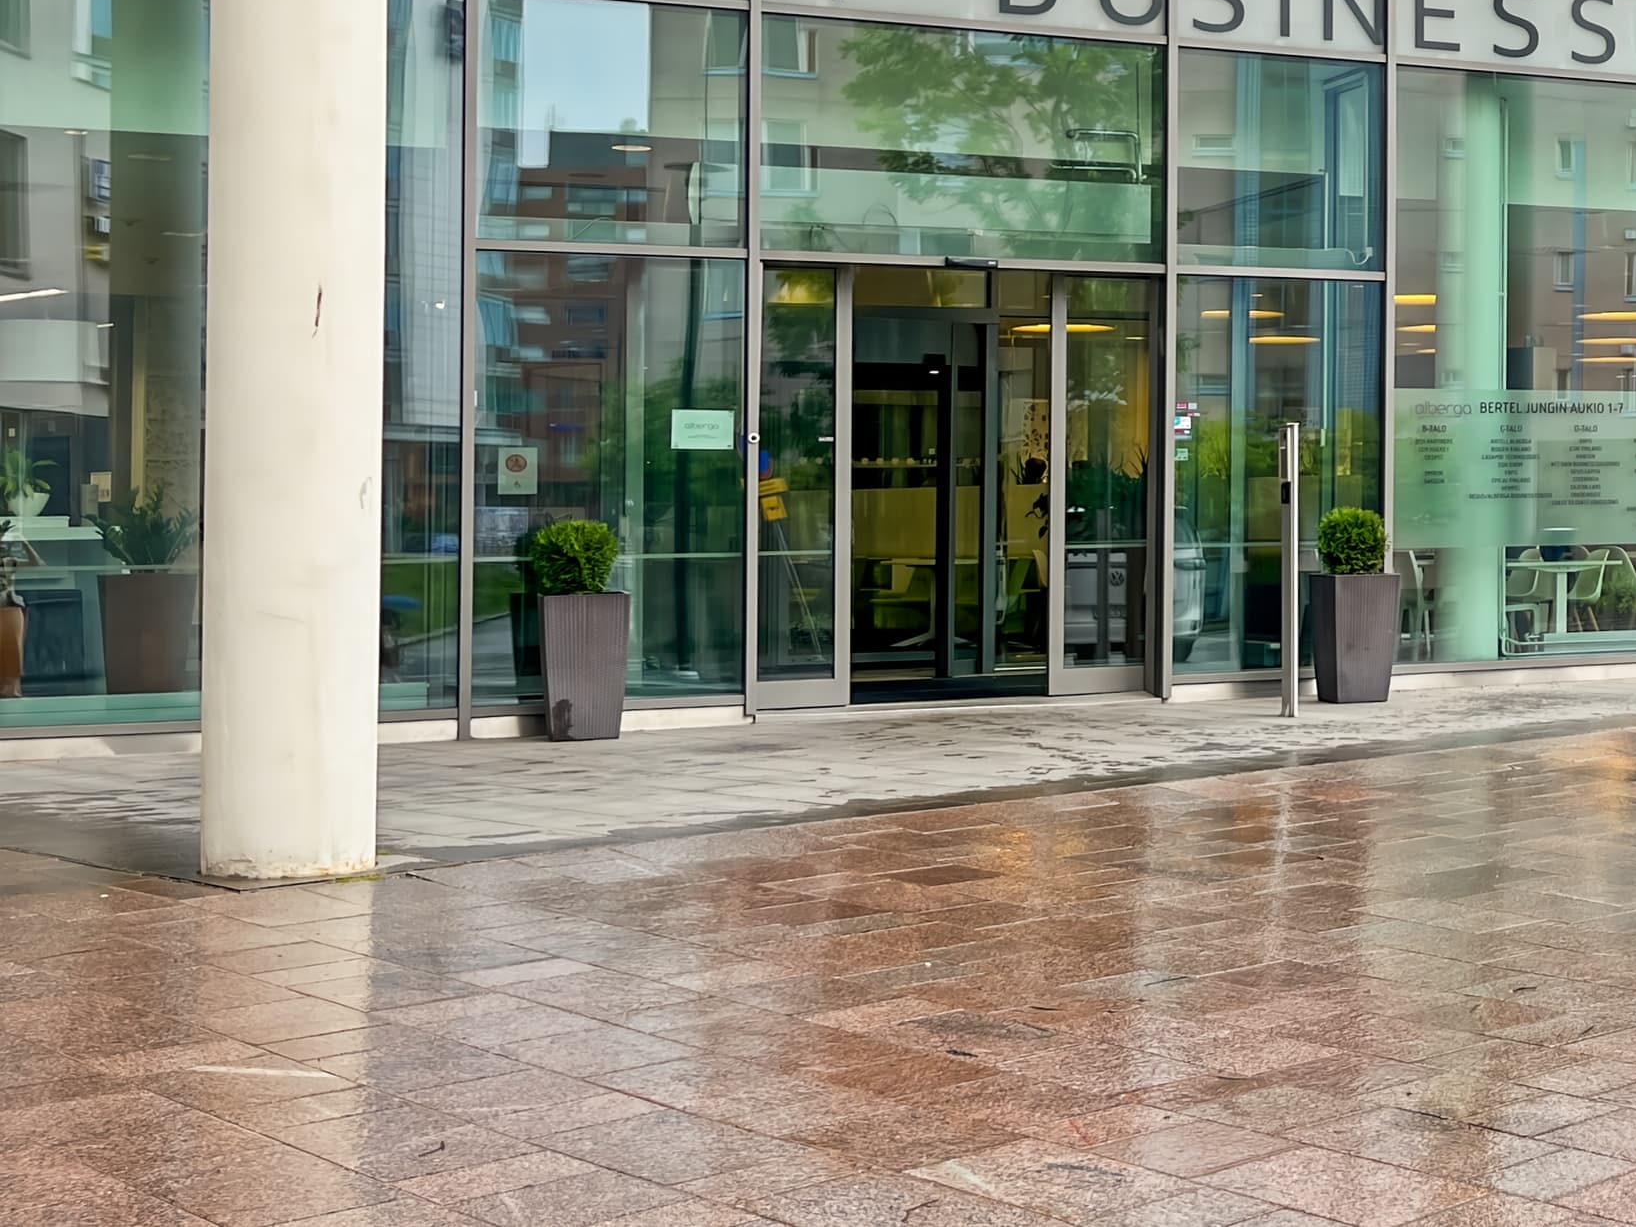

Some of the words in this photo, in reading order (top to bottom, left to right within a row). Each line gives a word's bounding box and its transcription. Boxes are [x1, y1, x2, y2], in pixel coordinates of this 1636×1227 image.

[1480, 402, 1522, 414] BERTEL
[1525, 402, 1567, 414] JUNGIN
[1570, 402, 1605, 414] AUKIO
[1608, 402, 1624, 414] 1-7
